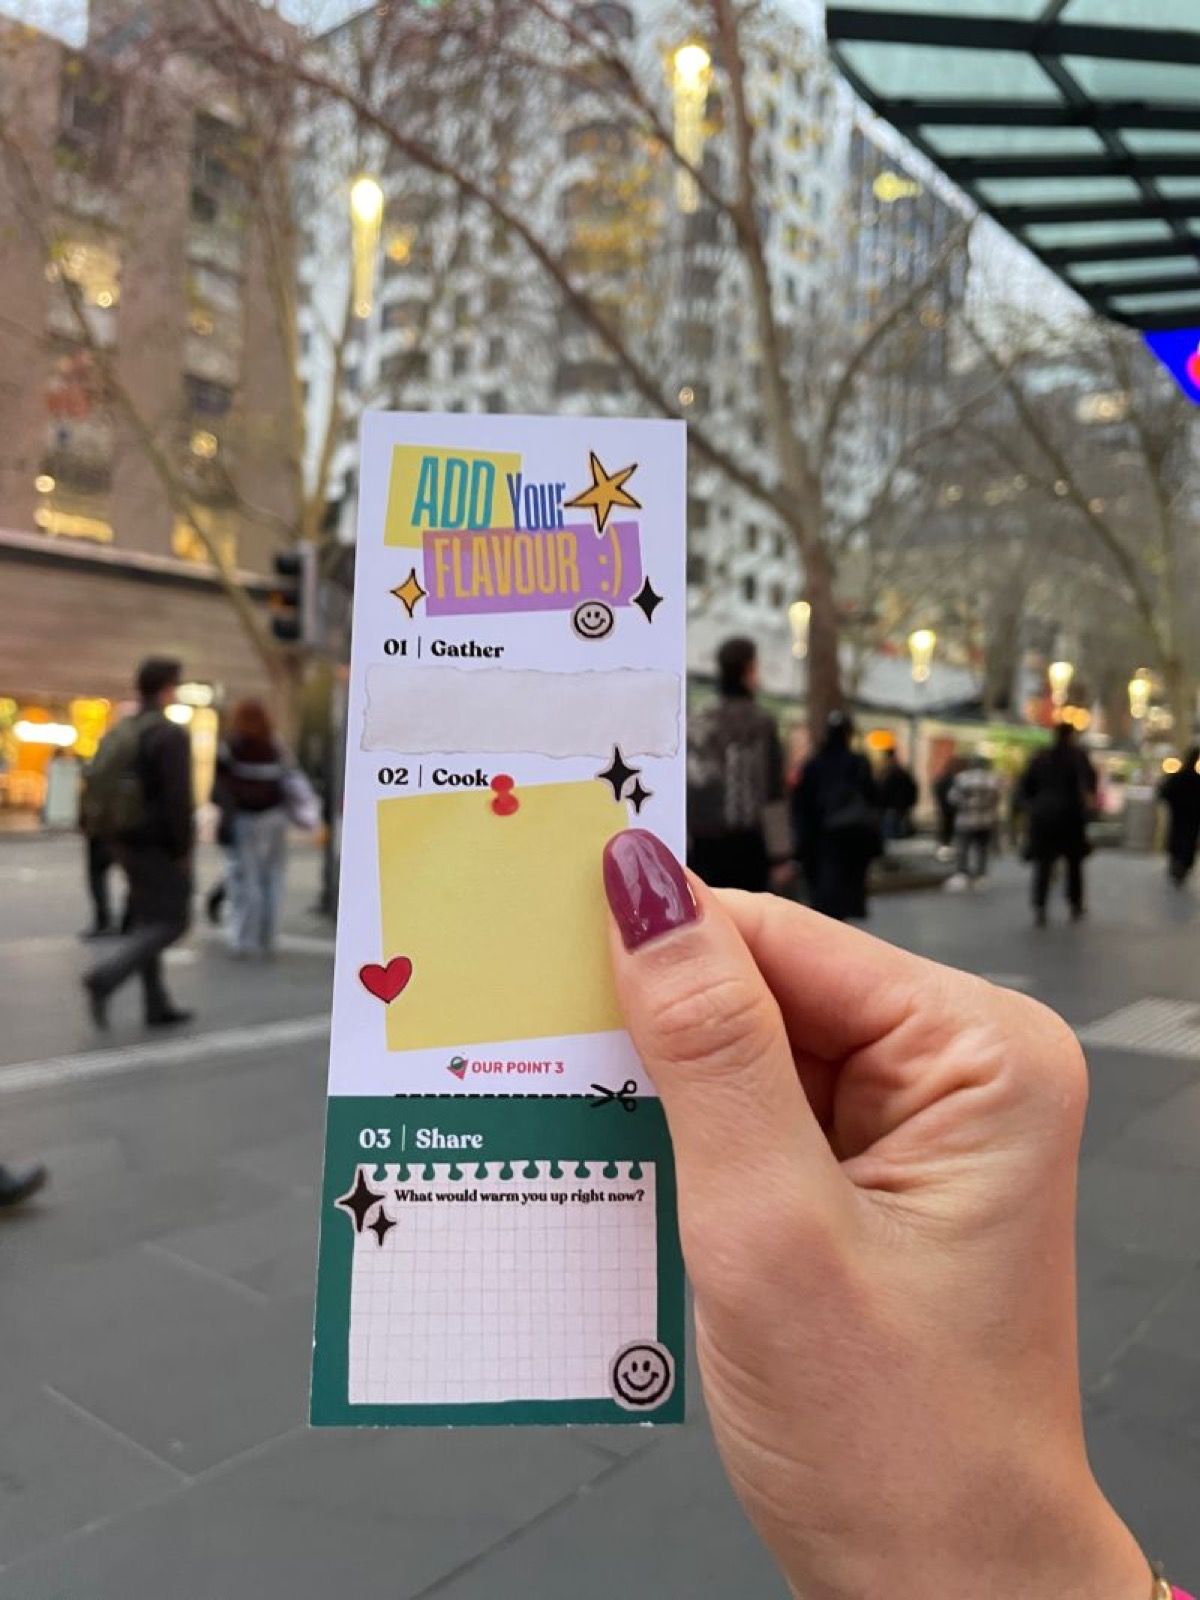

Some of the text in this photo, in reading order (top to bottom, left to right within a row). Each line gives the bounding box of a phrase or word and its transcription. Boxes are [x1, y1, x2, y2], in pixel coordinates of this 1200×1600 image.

[411, 455, 496, 531] ADD
[434, 532, 581, 600] FLAVOUR
[383, 638, 505, 658] 01 Gather
[377, 767, 489, 786] 02 Cook
[472, 1061, 565, 1074] OUR POINT 3
[359, 1127, 483, 1149] 03 Share
[394, 1188, 645, 1206] What would warm you up right now?
